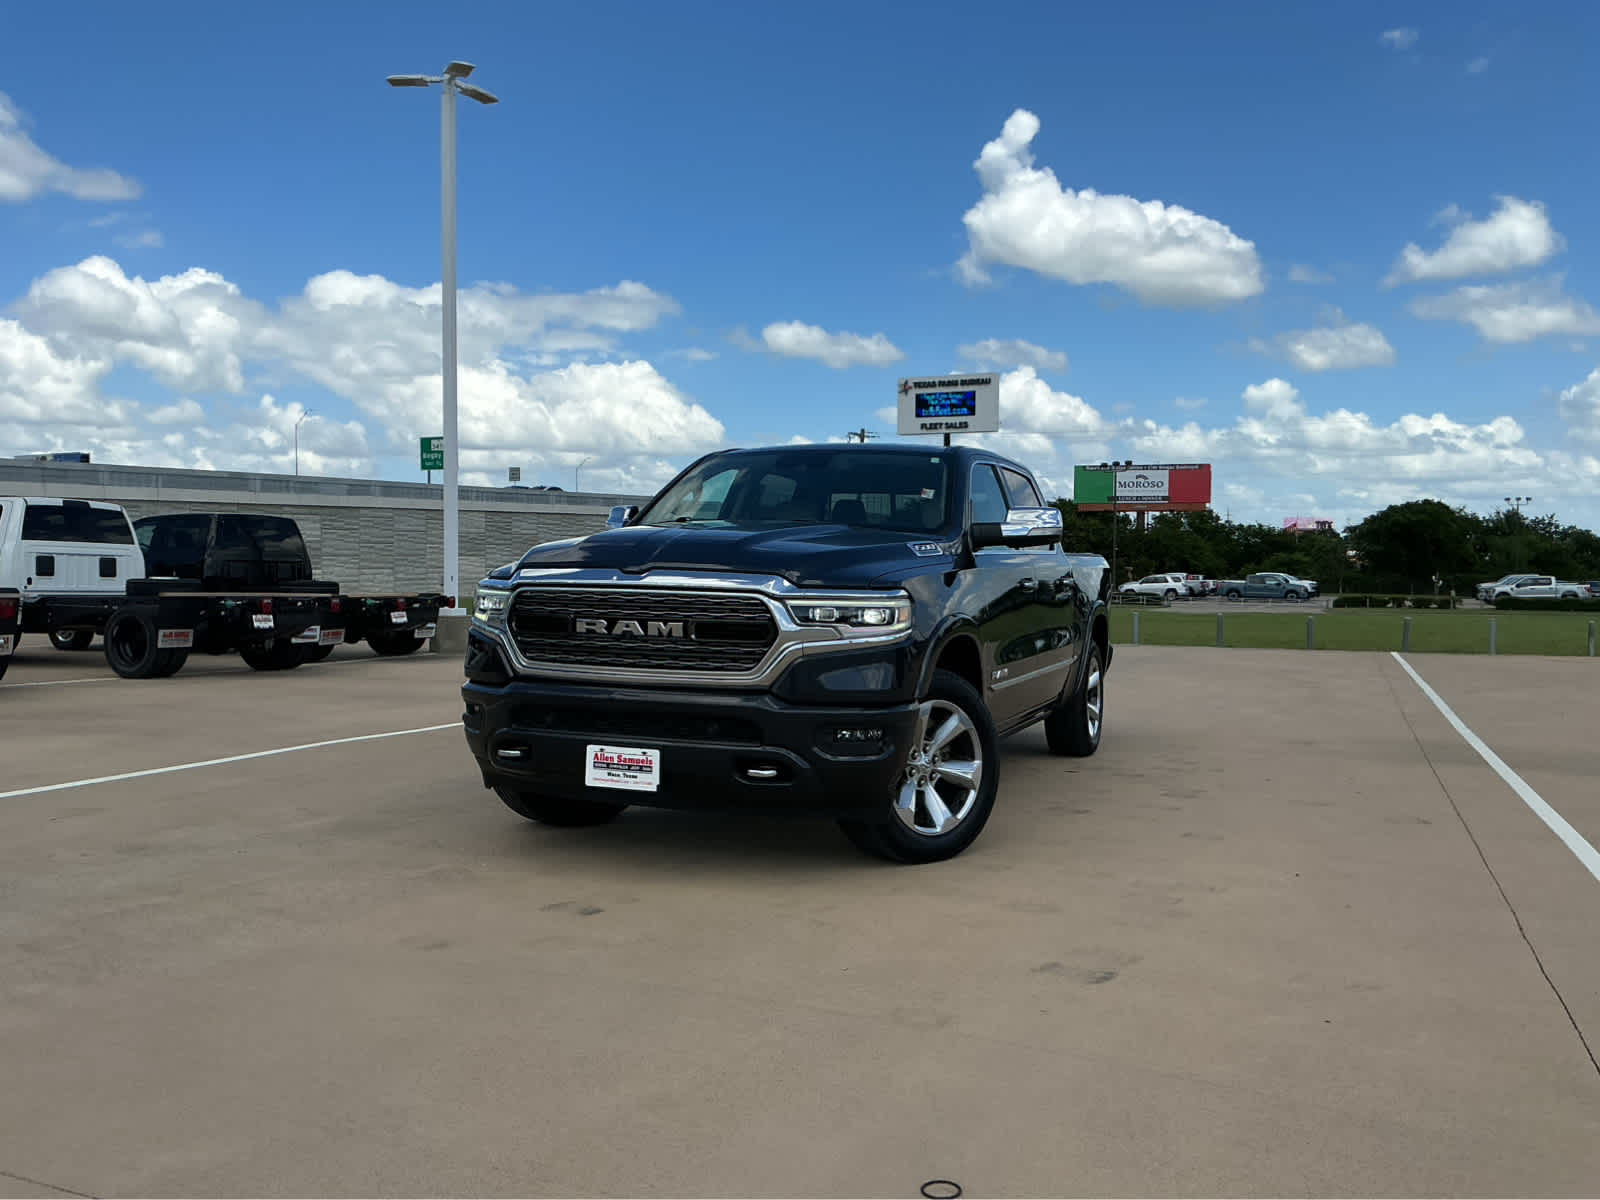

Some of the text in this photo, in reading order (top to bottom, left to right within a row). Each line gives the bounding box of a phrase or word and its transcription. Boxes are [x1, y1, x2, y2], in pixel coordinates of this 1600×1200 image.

[921, 421, 969, 430] FLEET SALES
[1118, 480, 1164, 489] MOROSO
[576, 618, 684, 637] RAM
[594, 752, 654, 766] Allen Samuels
